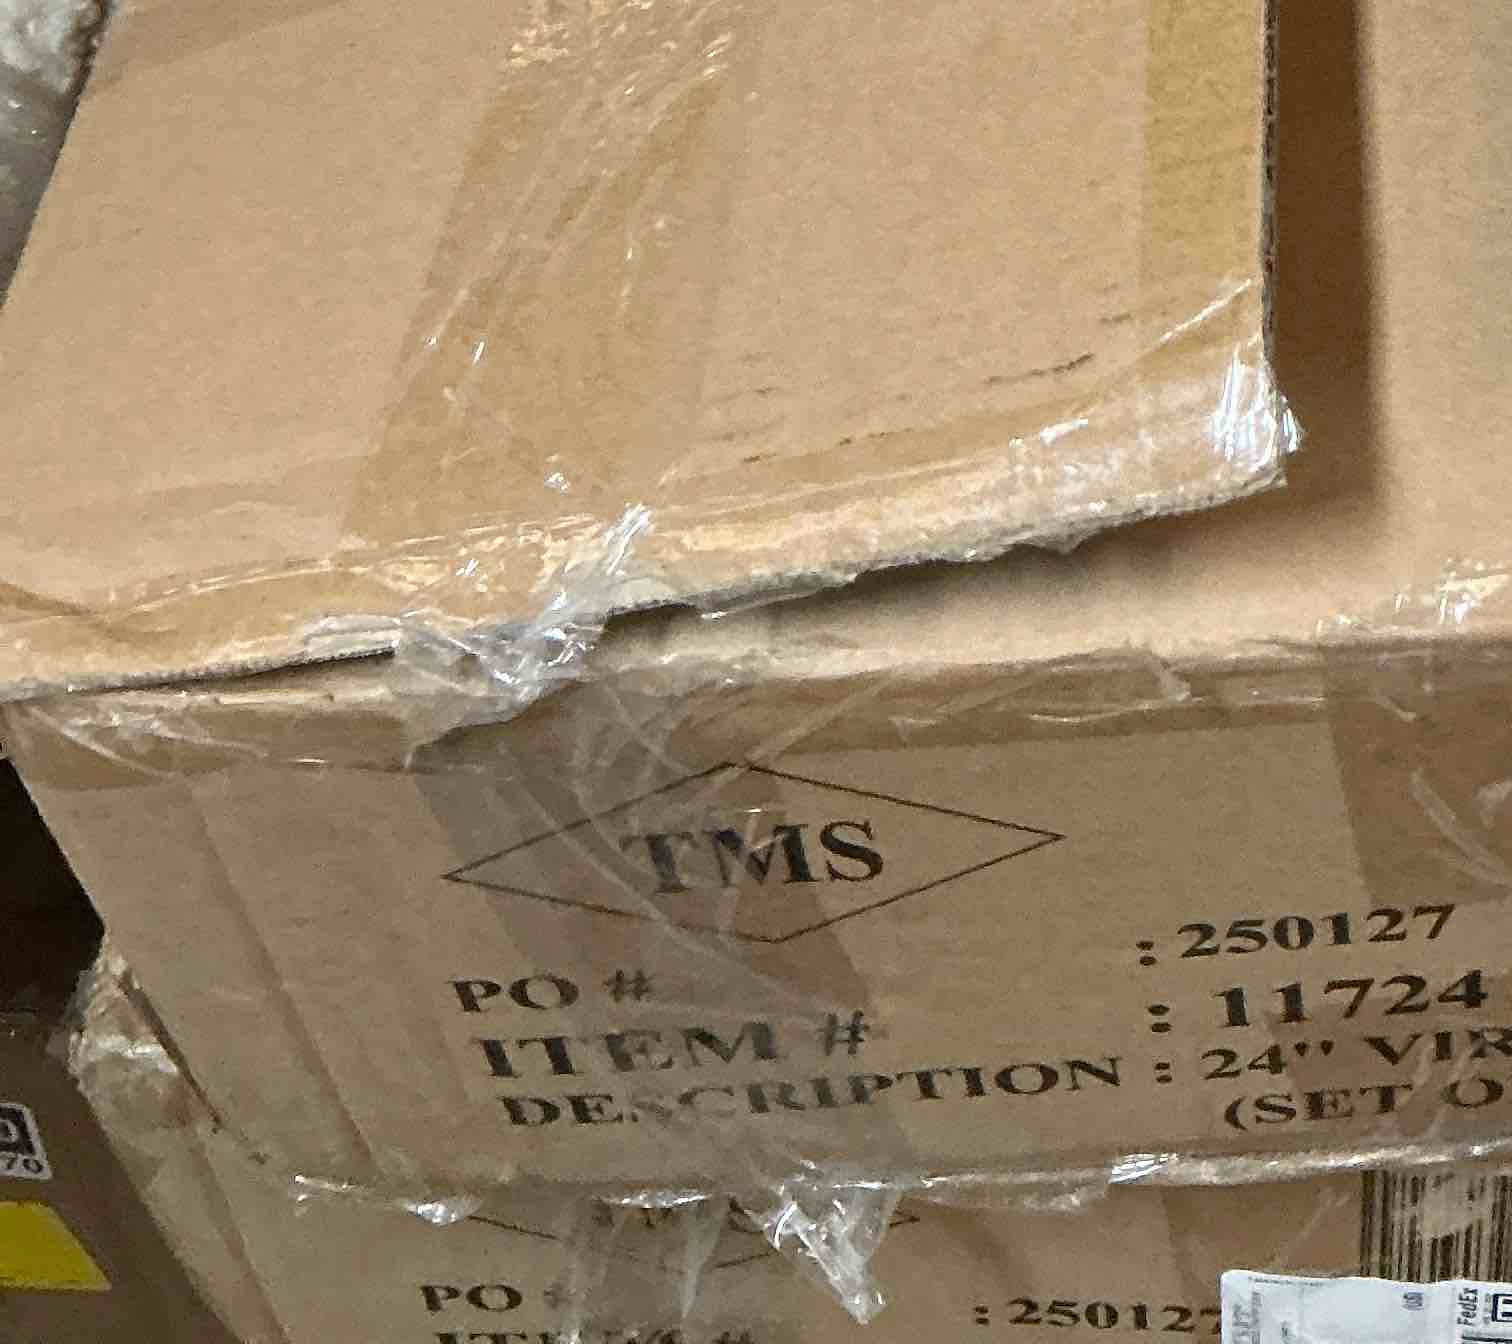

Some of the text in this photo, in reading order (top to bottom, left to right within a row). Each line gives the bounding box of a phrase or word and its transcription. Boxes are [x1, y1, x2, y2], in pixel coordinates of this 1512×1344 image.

[620, 820, 884, 893] TMS
[445, 972, 580, 1012] PO
[602, 968, 656, 1003] #
[1176, 903, 1456, 960] 250127
[470, 1020, 790, 1079] ITEM
[818, 1010, 870, 1057] #
[1211, 968, 1489, 1028] 11724
[497, 1057, 1122, 1128] DESCRIPTION
[1224, 1080, 1414, 1132] (SET
[419, 1283, 523, 1314] PO
[1456, 1287, 1479, 1327] FedEx
